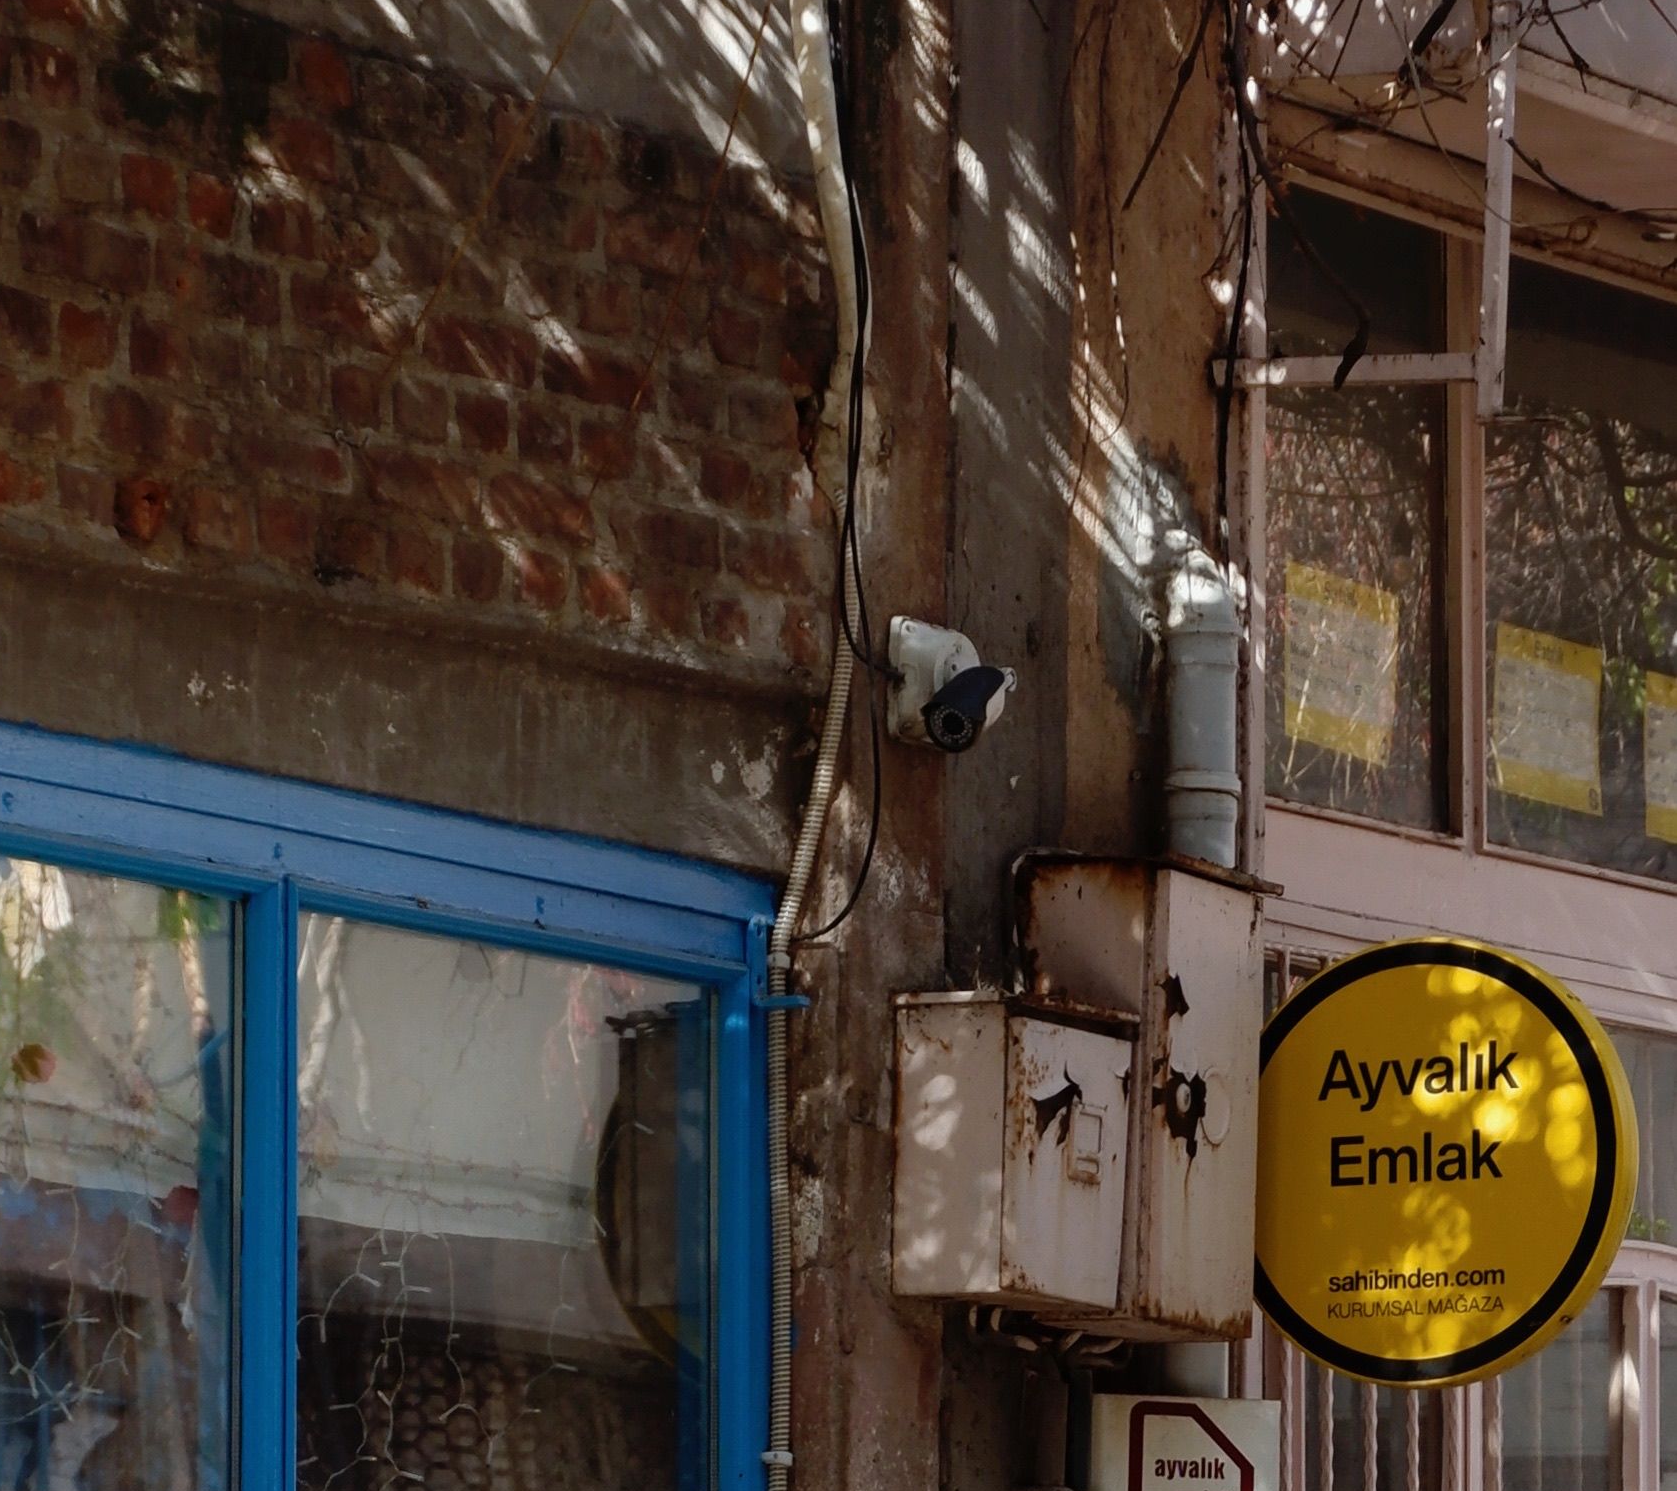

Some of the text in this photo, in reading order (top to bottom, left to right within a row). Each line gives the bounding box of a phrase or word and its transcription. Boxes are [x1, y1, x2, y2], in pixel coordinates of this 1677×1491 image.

[1318, 1040, 1519, 1112] Ayvalık
[1330, 1129, 1503, 1187] Emlak
[1329, 1267, 1505, 1293] sahibinden.com
[1328, 1294, 1505, 1319] KURUMSAL MAĞAZA
[1155, 1457, 1225, 1480] ayvalık
